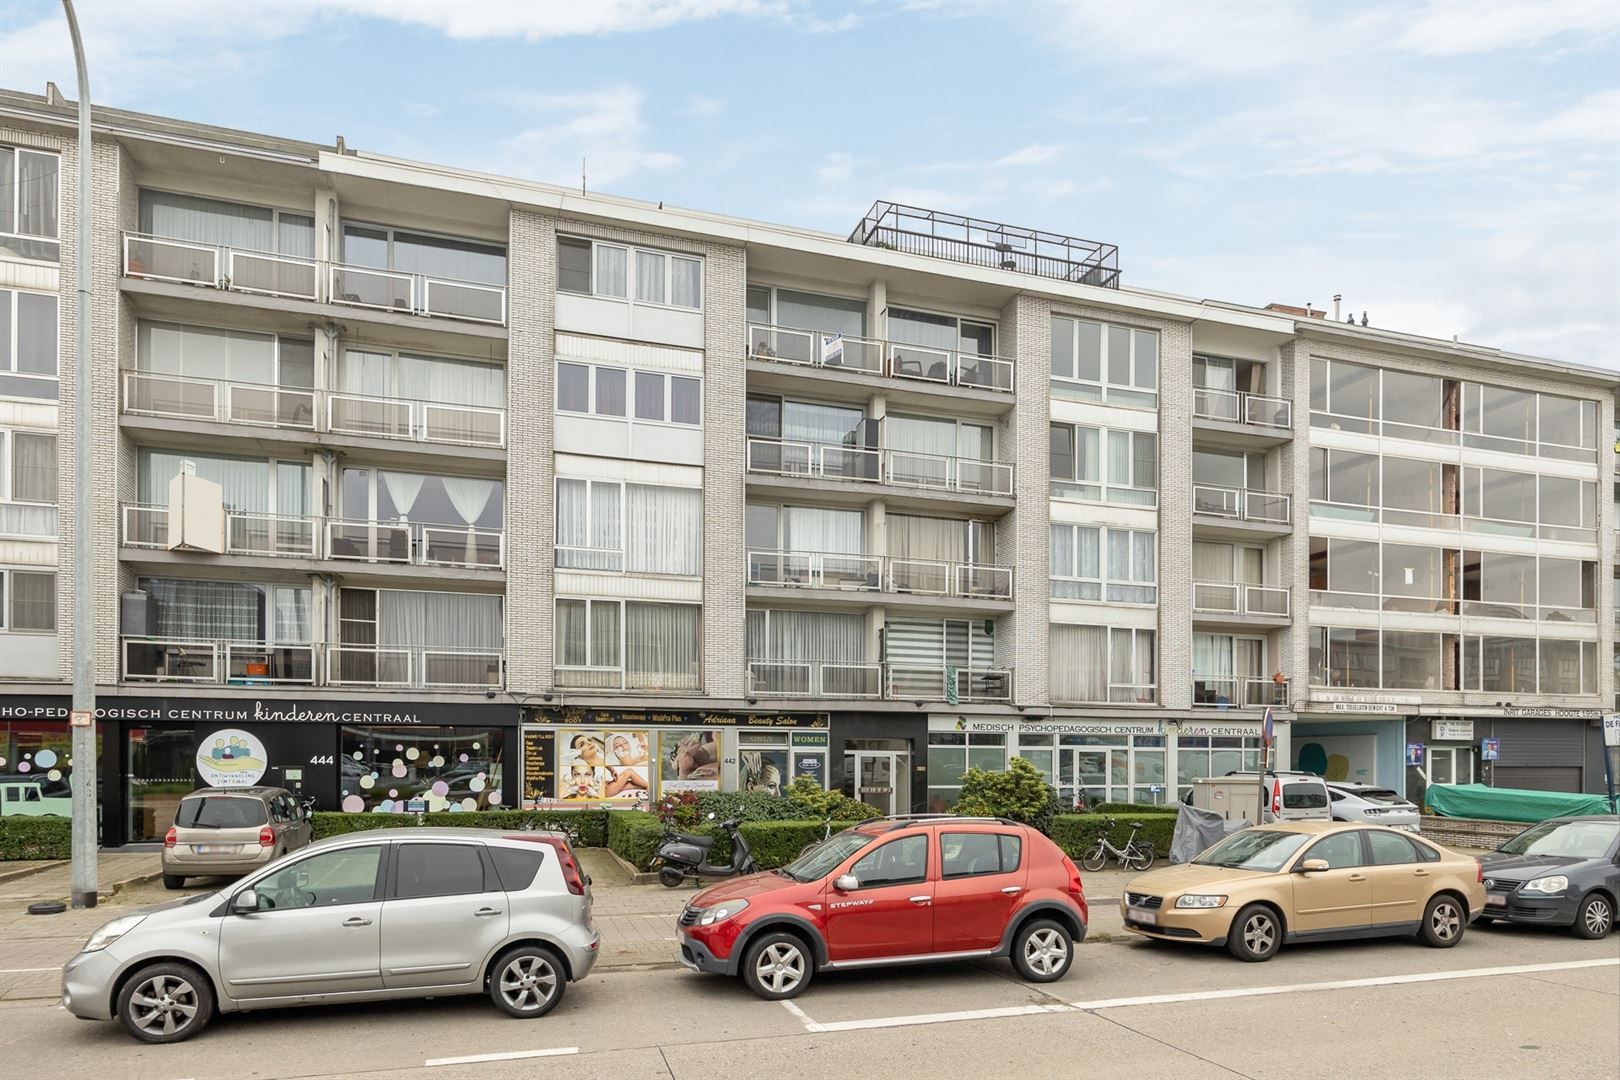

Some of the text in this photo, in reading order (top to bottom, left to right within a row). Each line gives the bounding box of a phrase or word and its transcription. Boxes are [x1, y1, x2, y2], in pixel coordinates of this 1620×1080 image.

[168, 709, 247, 720] CENTRUM
[253, 701, 340, 722] kinderen
[341, 713, 421, 723] CENTRAAL
[1522, 709, 1552, 717] GARAGES
[1555, 709, 1580, 718] HOOGTE
[703, 714, 797, 726] Adriana Beauty Salon
[972, 723, 1014, 731] MEDISCH
[1018, 724, 1112, 733] PSYCHOPEDAGOGISCH
[1114, 726, 1154, 734] CENTRUM
[1211, 727, 1260, 736] CENTRAAL
[309, 755, 334, 765] 444
[829, 900, 870, 909] STEPWAY
